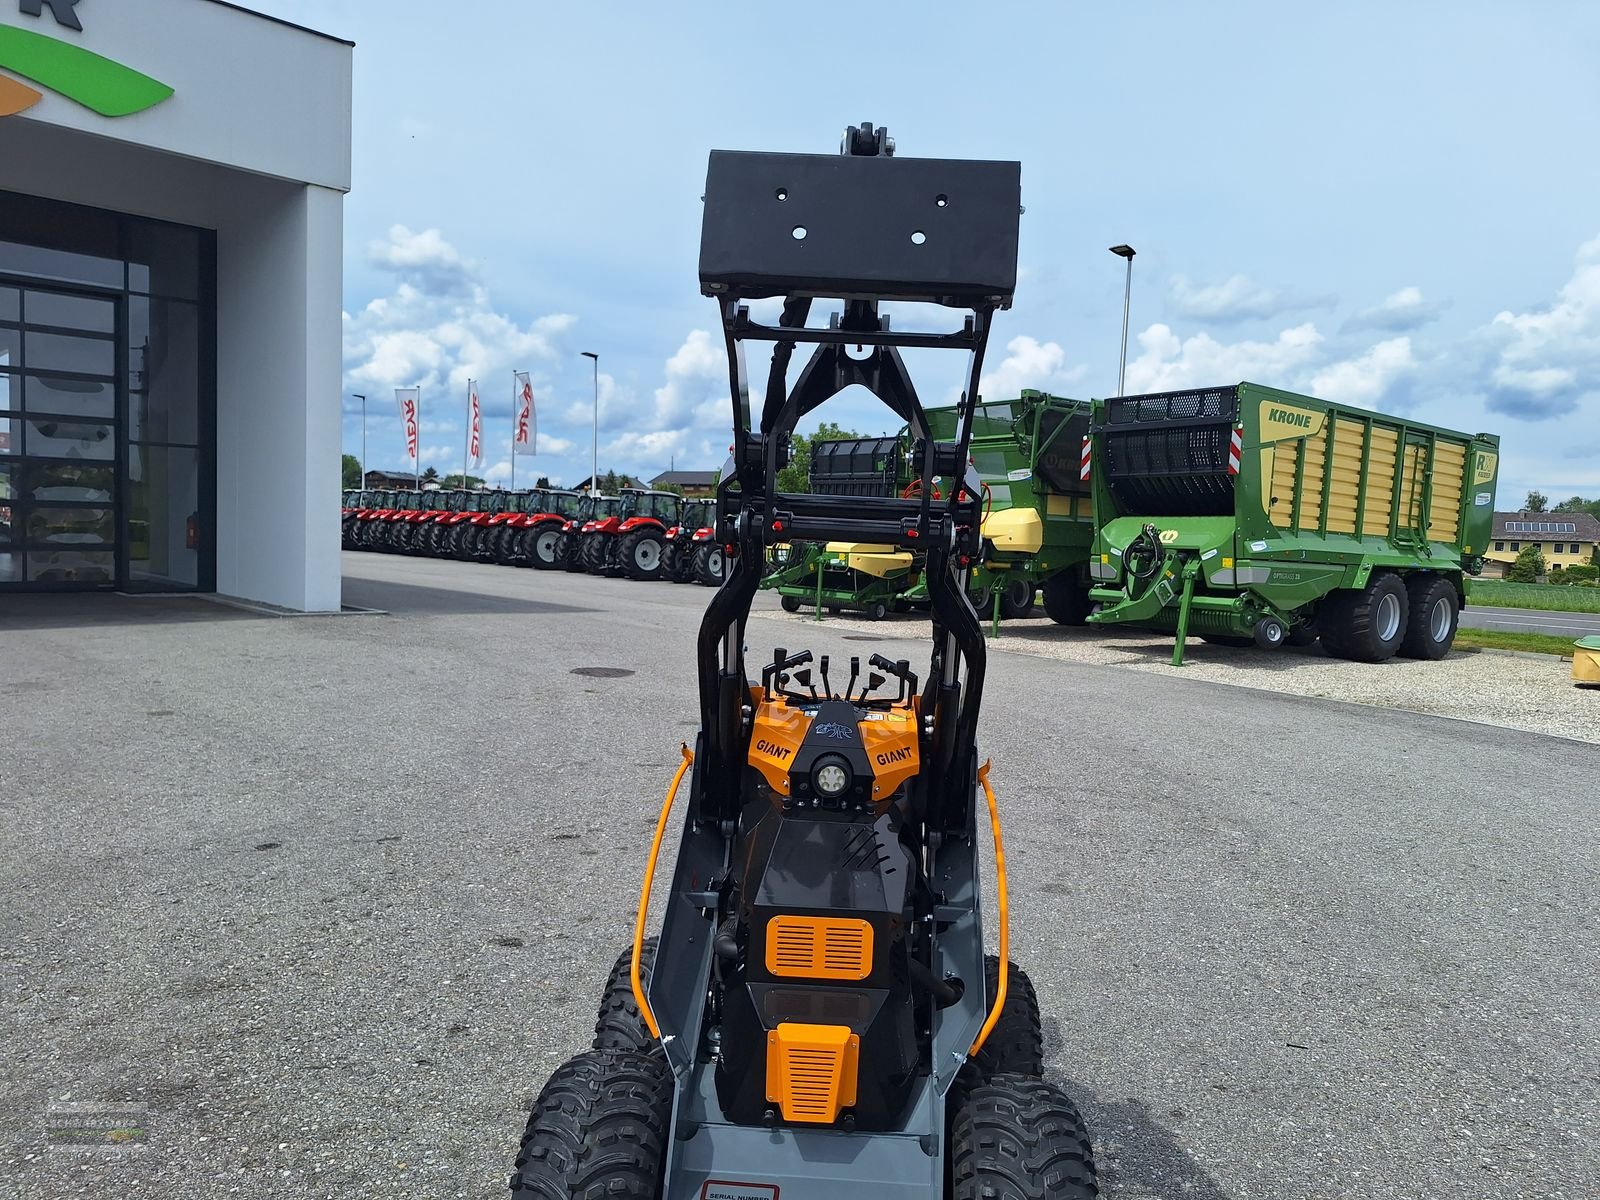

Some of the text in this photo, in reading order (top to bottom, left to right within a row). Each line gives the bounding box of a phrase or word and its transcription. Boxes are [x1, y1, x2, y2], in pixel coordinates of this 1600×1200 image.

[1268, 408, 1312, 428] KRONE
[756, 739, 791, 760] GIANT
[876, 746, 913, 766] GIANT
